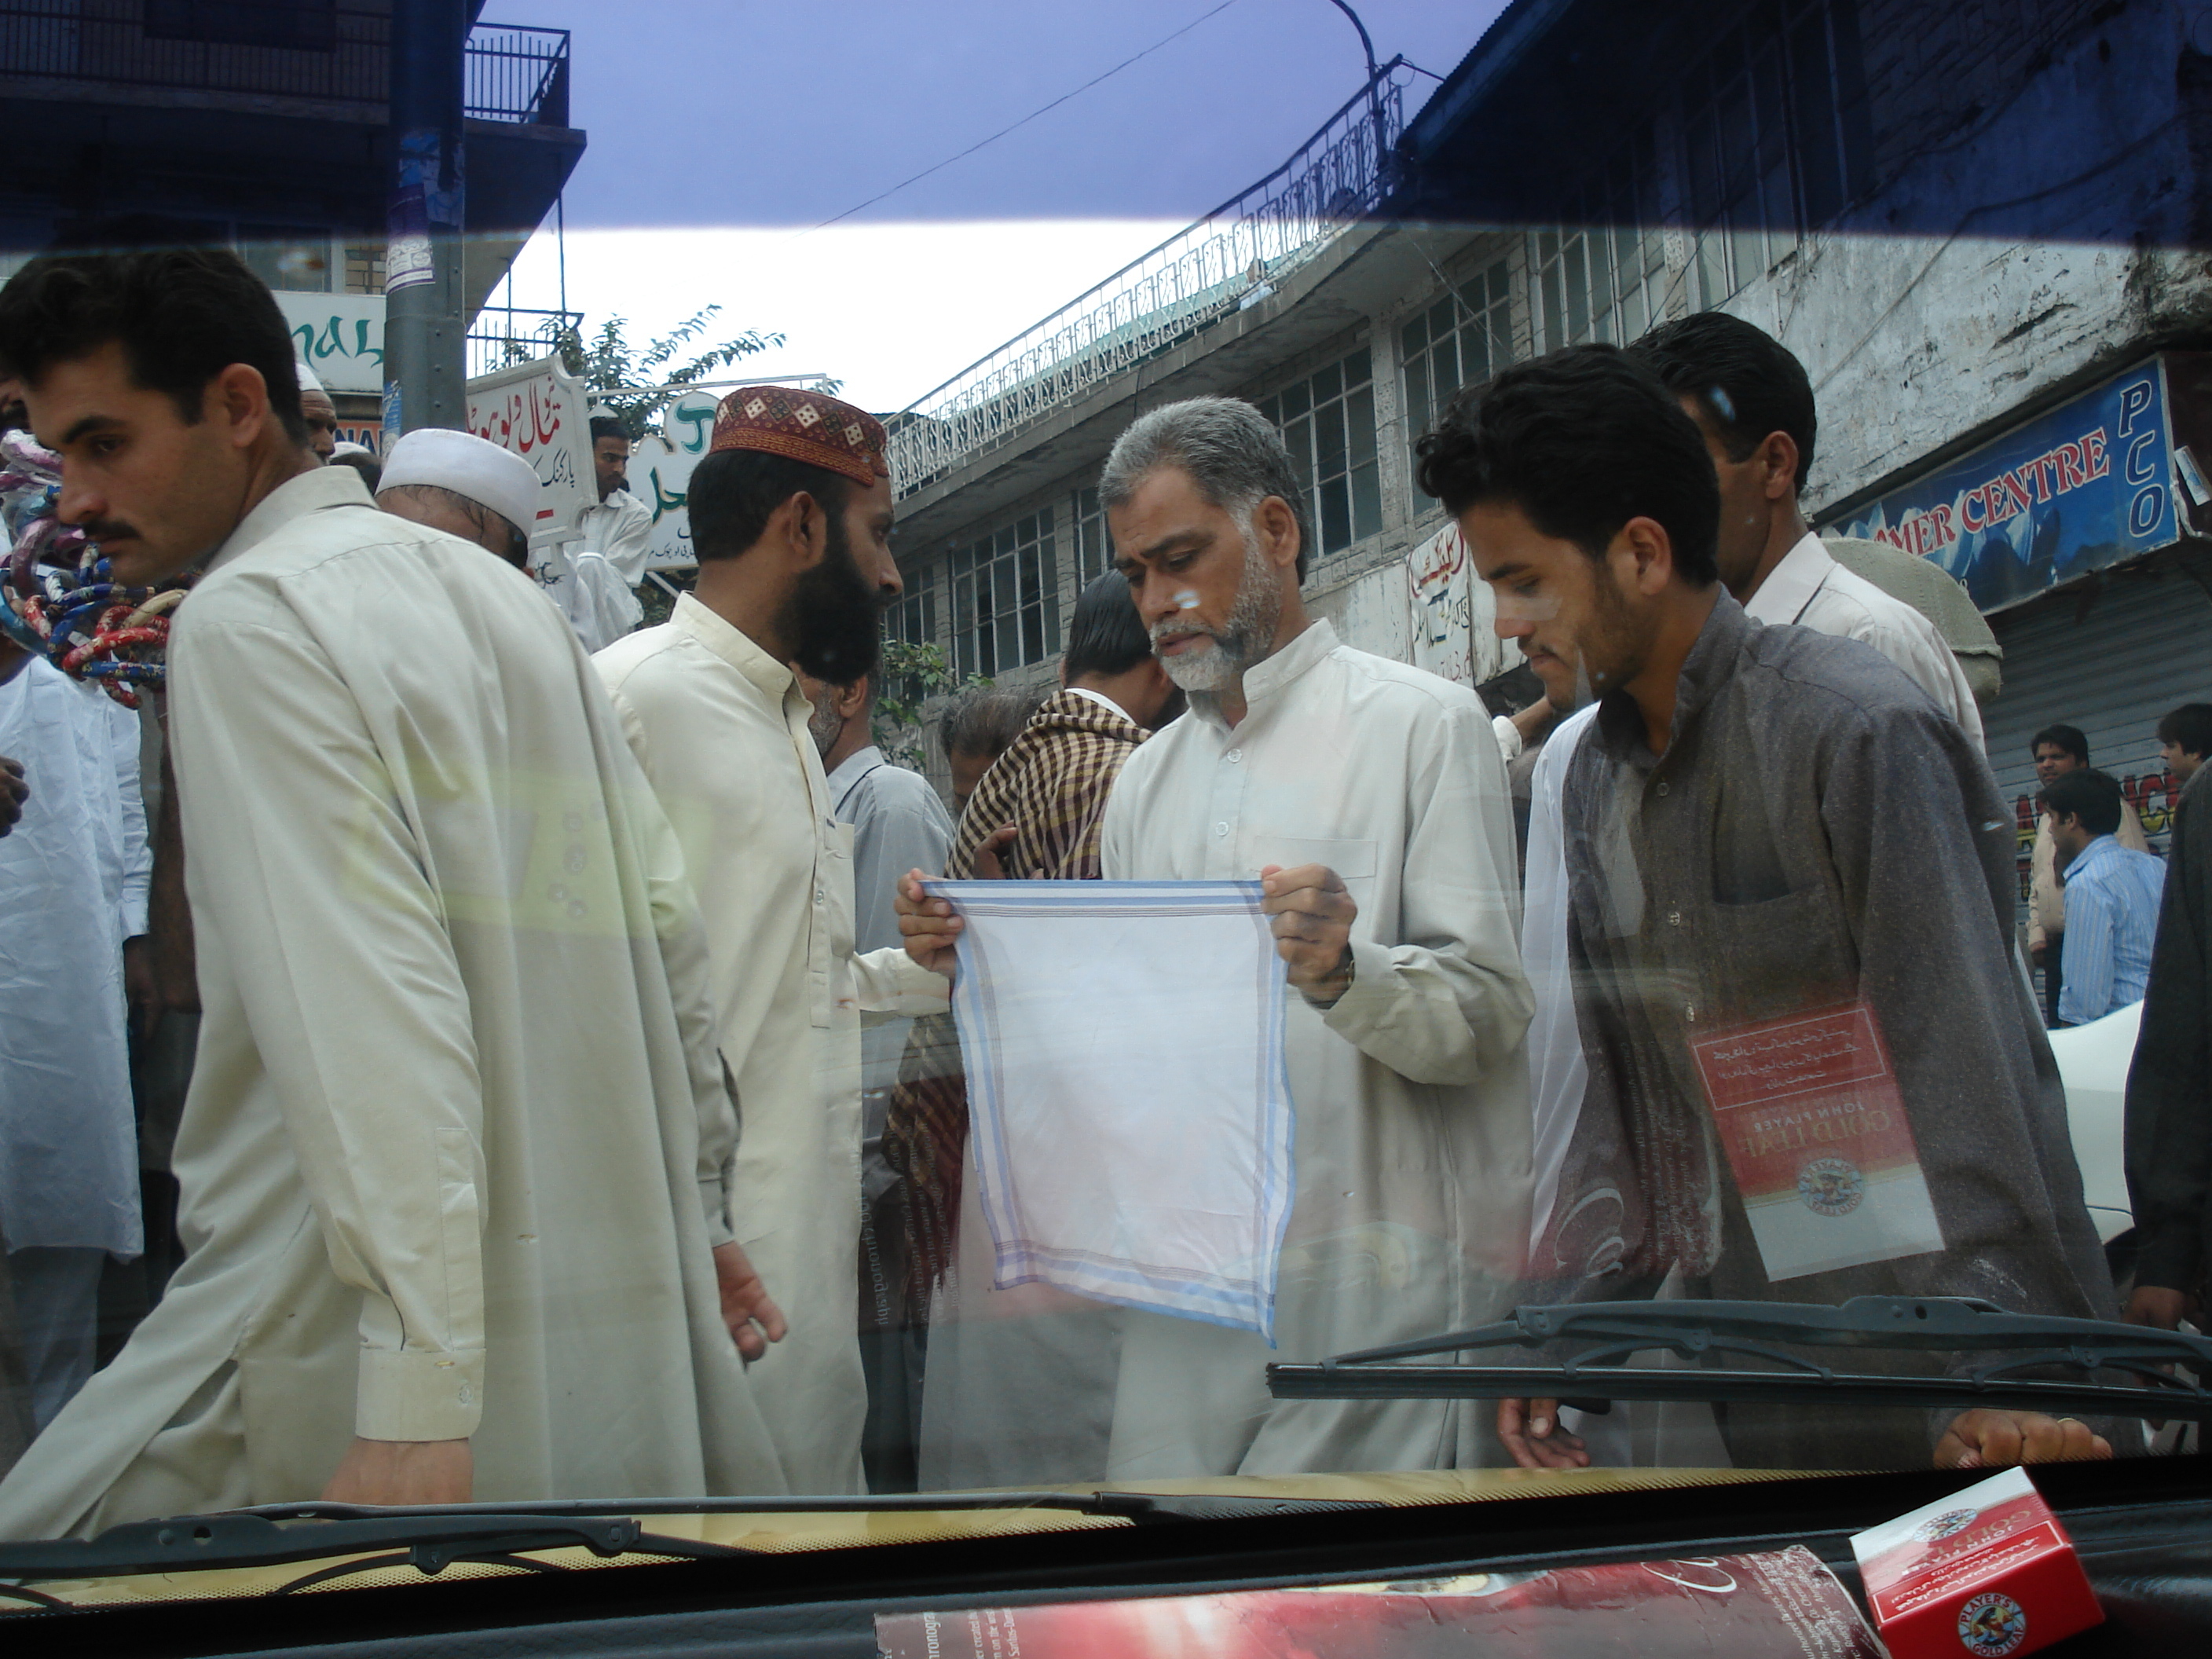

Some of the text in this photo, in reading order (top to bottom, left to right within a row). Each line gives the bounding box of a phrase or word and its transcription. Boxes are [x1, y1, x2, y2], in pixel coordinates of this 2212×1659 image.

[1874, 427, 2111, 556] MER CENTRE
[2119, 380, 2164, 538] PCO
[1961, 1593, 2012, 1623] PLAYER'S
[1972, 1625, 2023, 1657] GOLD LEAF
